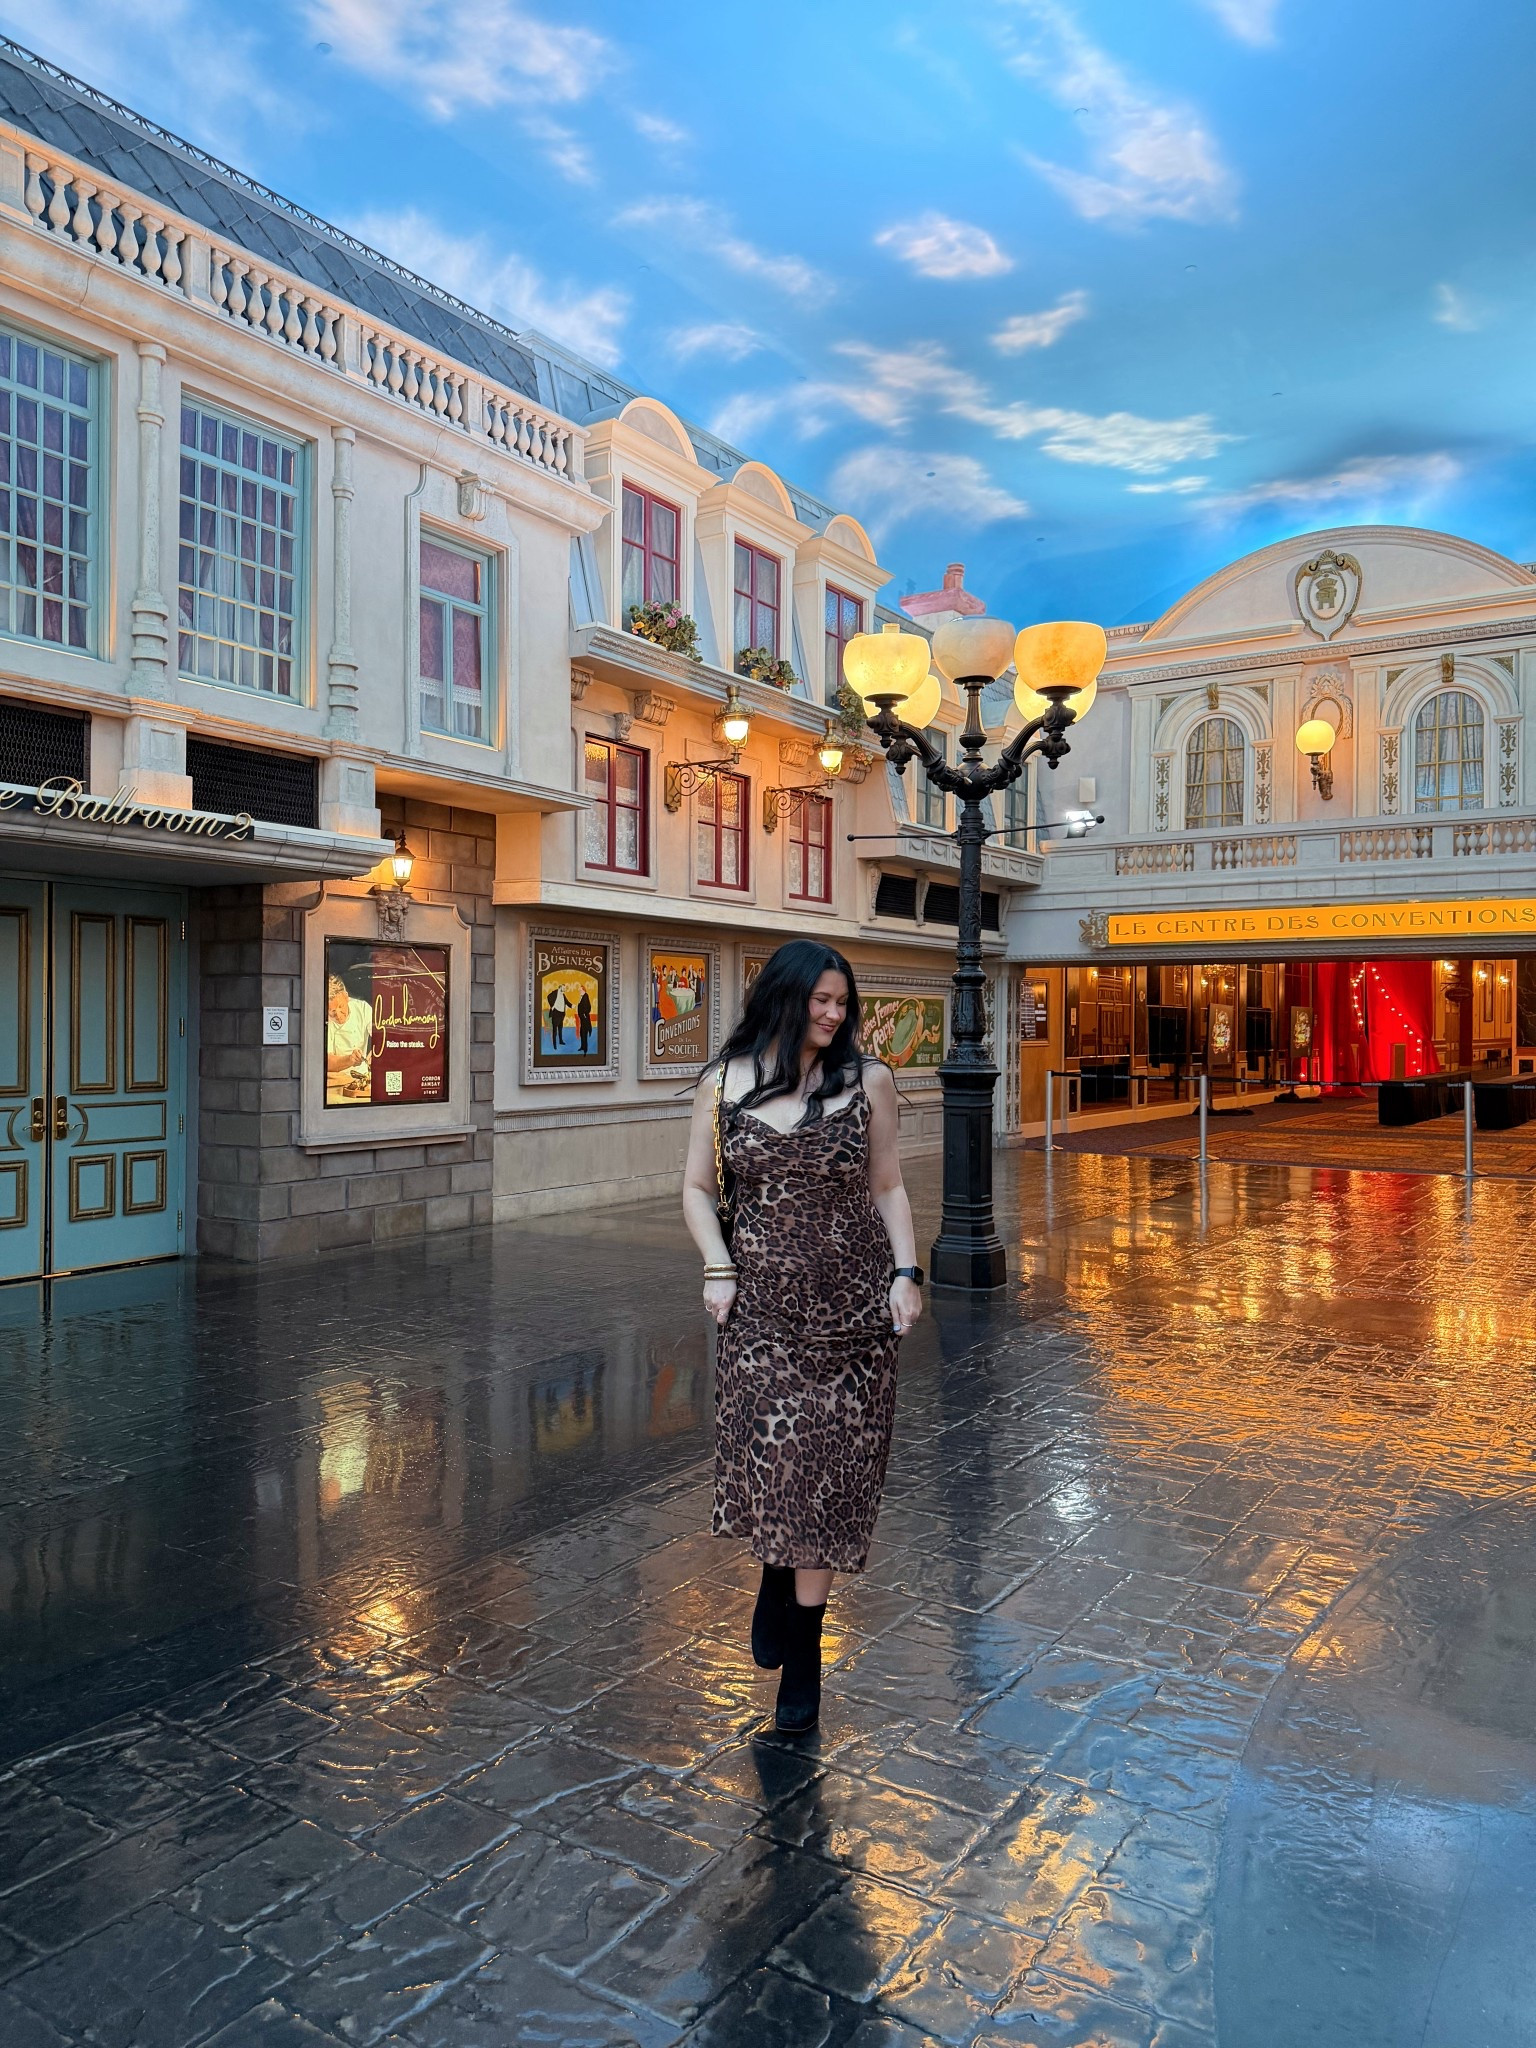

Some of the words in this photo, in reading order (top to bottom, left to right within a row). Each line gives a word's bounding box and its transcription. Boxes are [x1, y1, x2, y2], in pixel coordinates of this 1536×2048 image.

[33, 775, 225, 837] Ballroom
[223, 812, 252, 841] 2
[1115, 922, 1146, 936] LE
[1156, 917, 1256, 935] CENTRE
[1267, 915, 1319, 931] DES
[1331, 907, 1536, 928] CONVENTIONS
[536, 952, 604, 976] BUSINESS
[551, 946, 580, 955] Affaires
[580, 948, 591, 956] Du
[874, 1000, 900, 1027] Femmes
[399, 1040, 407, 1048] the
[654, 1015, 700, 1057] CONVENTIONS
[872, 1017, 896, 1058] Paris
